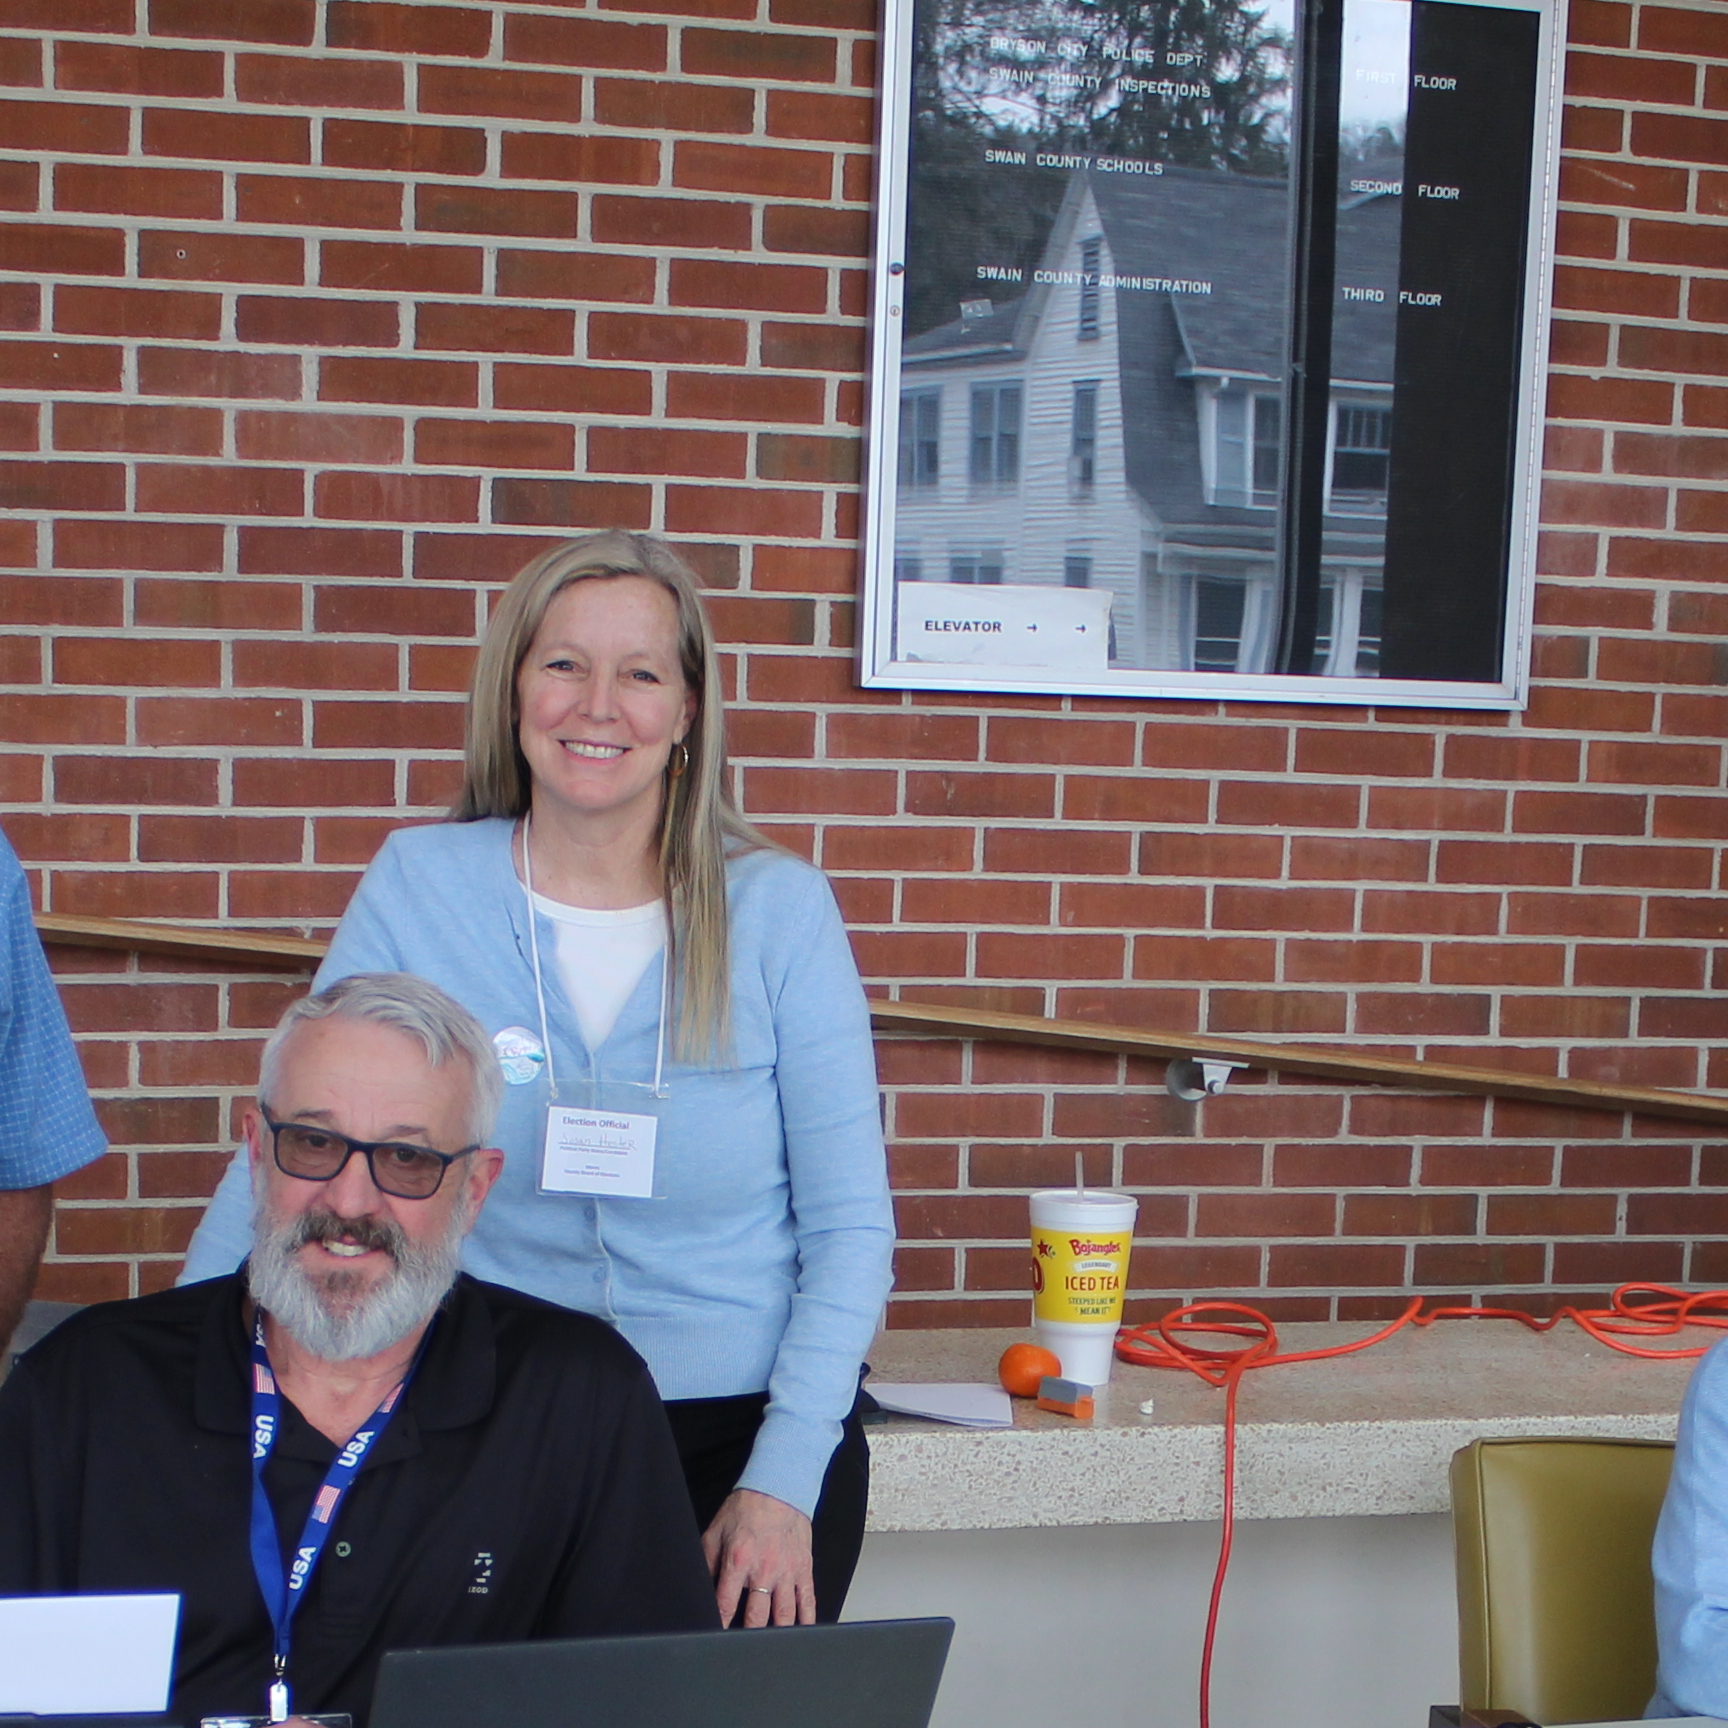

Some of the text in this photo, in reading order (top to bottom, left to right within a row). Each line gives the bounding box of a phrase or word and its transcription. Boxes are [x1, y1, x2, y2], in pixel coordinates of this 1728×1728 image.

[1057, 38, 1089, 58] CITY
[1102, 45, 1155, 63] POLICE
[988, 67, 1211, 98] SWAIN COUNTY INSPECTIONS
[1355, 69, 1457, 91] FIRST FLOOR
[984, 149, 1164, 176] SWAIN COUNTY SCHOOLS
[1350, 179, 1460, 200] SECOND FLOOR
[976, 265, 1212, 295] SWAIN COUNTY ADMINISTRATION
[1341, 286, 1442, 307] THIRD FLOOR
[924, 620, 1003, 633] ELEVATOR
[562, 1116, 630, 1130] Election Official
[1065, 1275, 1120, 1291] ICED TEA
[1079, 1307, 1100, 1316] MEAN
[253, 1414, 275, 1459] USA
[337, 1429, 375, 1468] USA
[288, 1545, 317, 1591] USA
[468, 1586, 489, 1594] IZOD
